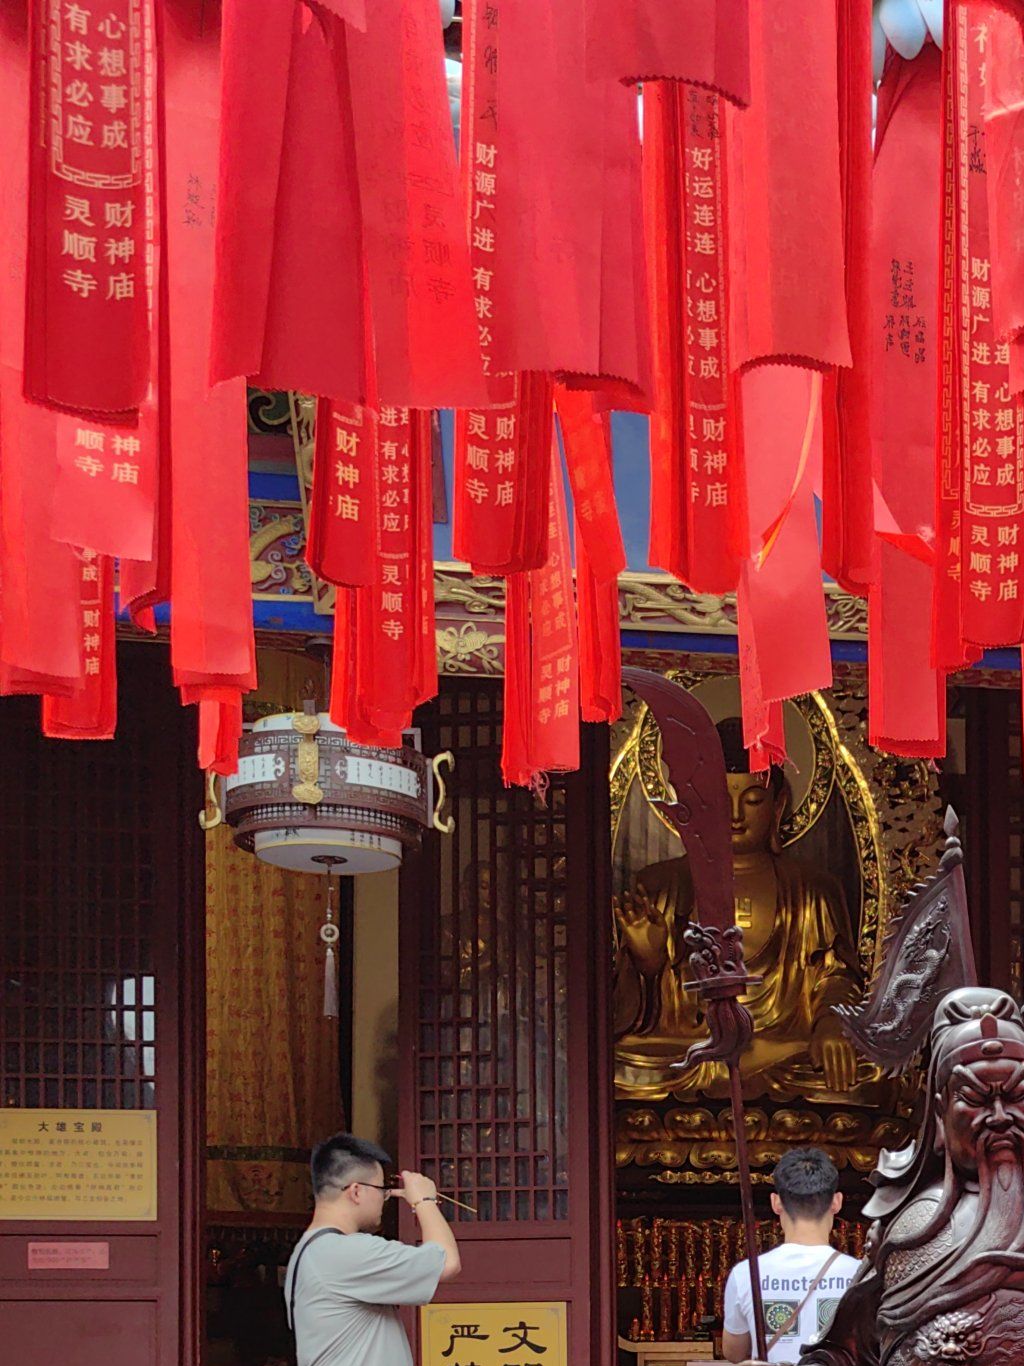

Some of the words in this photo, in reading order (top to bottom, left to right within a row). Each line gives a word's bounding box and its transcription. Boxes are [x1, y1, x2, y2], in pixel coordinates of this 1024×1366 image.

[64, 2, 94, 146] 有求必应
[97, 13, 128, 149] 心想事成
[472, 142, 498, 252] 财源广进
[691, 146, 715, 255] 好运连连
[61, 195, 97, 298] 灵顺寺
[104, 200, 135, 300] 财神庙
[472, 267, 495, 377] 有求必
[696, 272, 720, 379] 心想事成
[971, 257, 991, 365] 财源广进
[74, 428, 105, 478] 顺寺
[111, 434, 141, 485] 神庙
[335, 428, 360, 521] 财神庙
[466, 411, 490, 504] 灵顺寺
[494, 414, 517, 506] 财神庙
[703, 417, 727, 507] 财神庙
[971, 380, 992, 487] 有求必应
[995, 381, 1015, 486] 心想事成
[381, 441, 400, 532] 有求必应
[381, 564, 404, 640] 灵顺寺
[969, 524, 993, 602] 灵顺寺
[996, 523, 1020, 602] 财神庙
[83, 609, 100, 676] 财神庙
[554, 654, 572, 718] 财神庙
